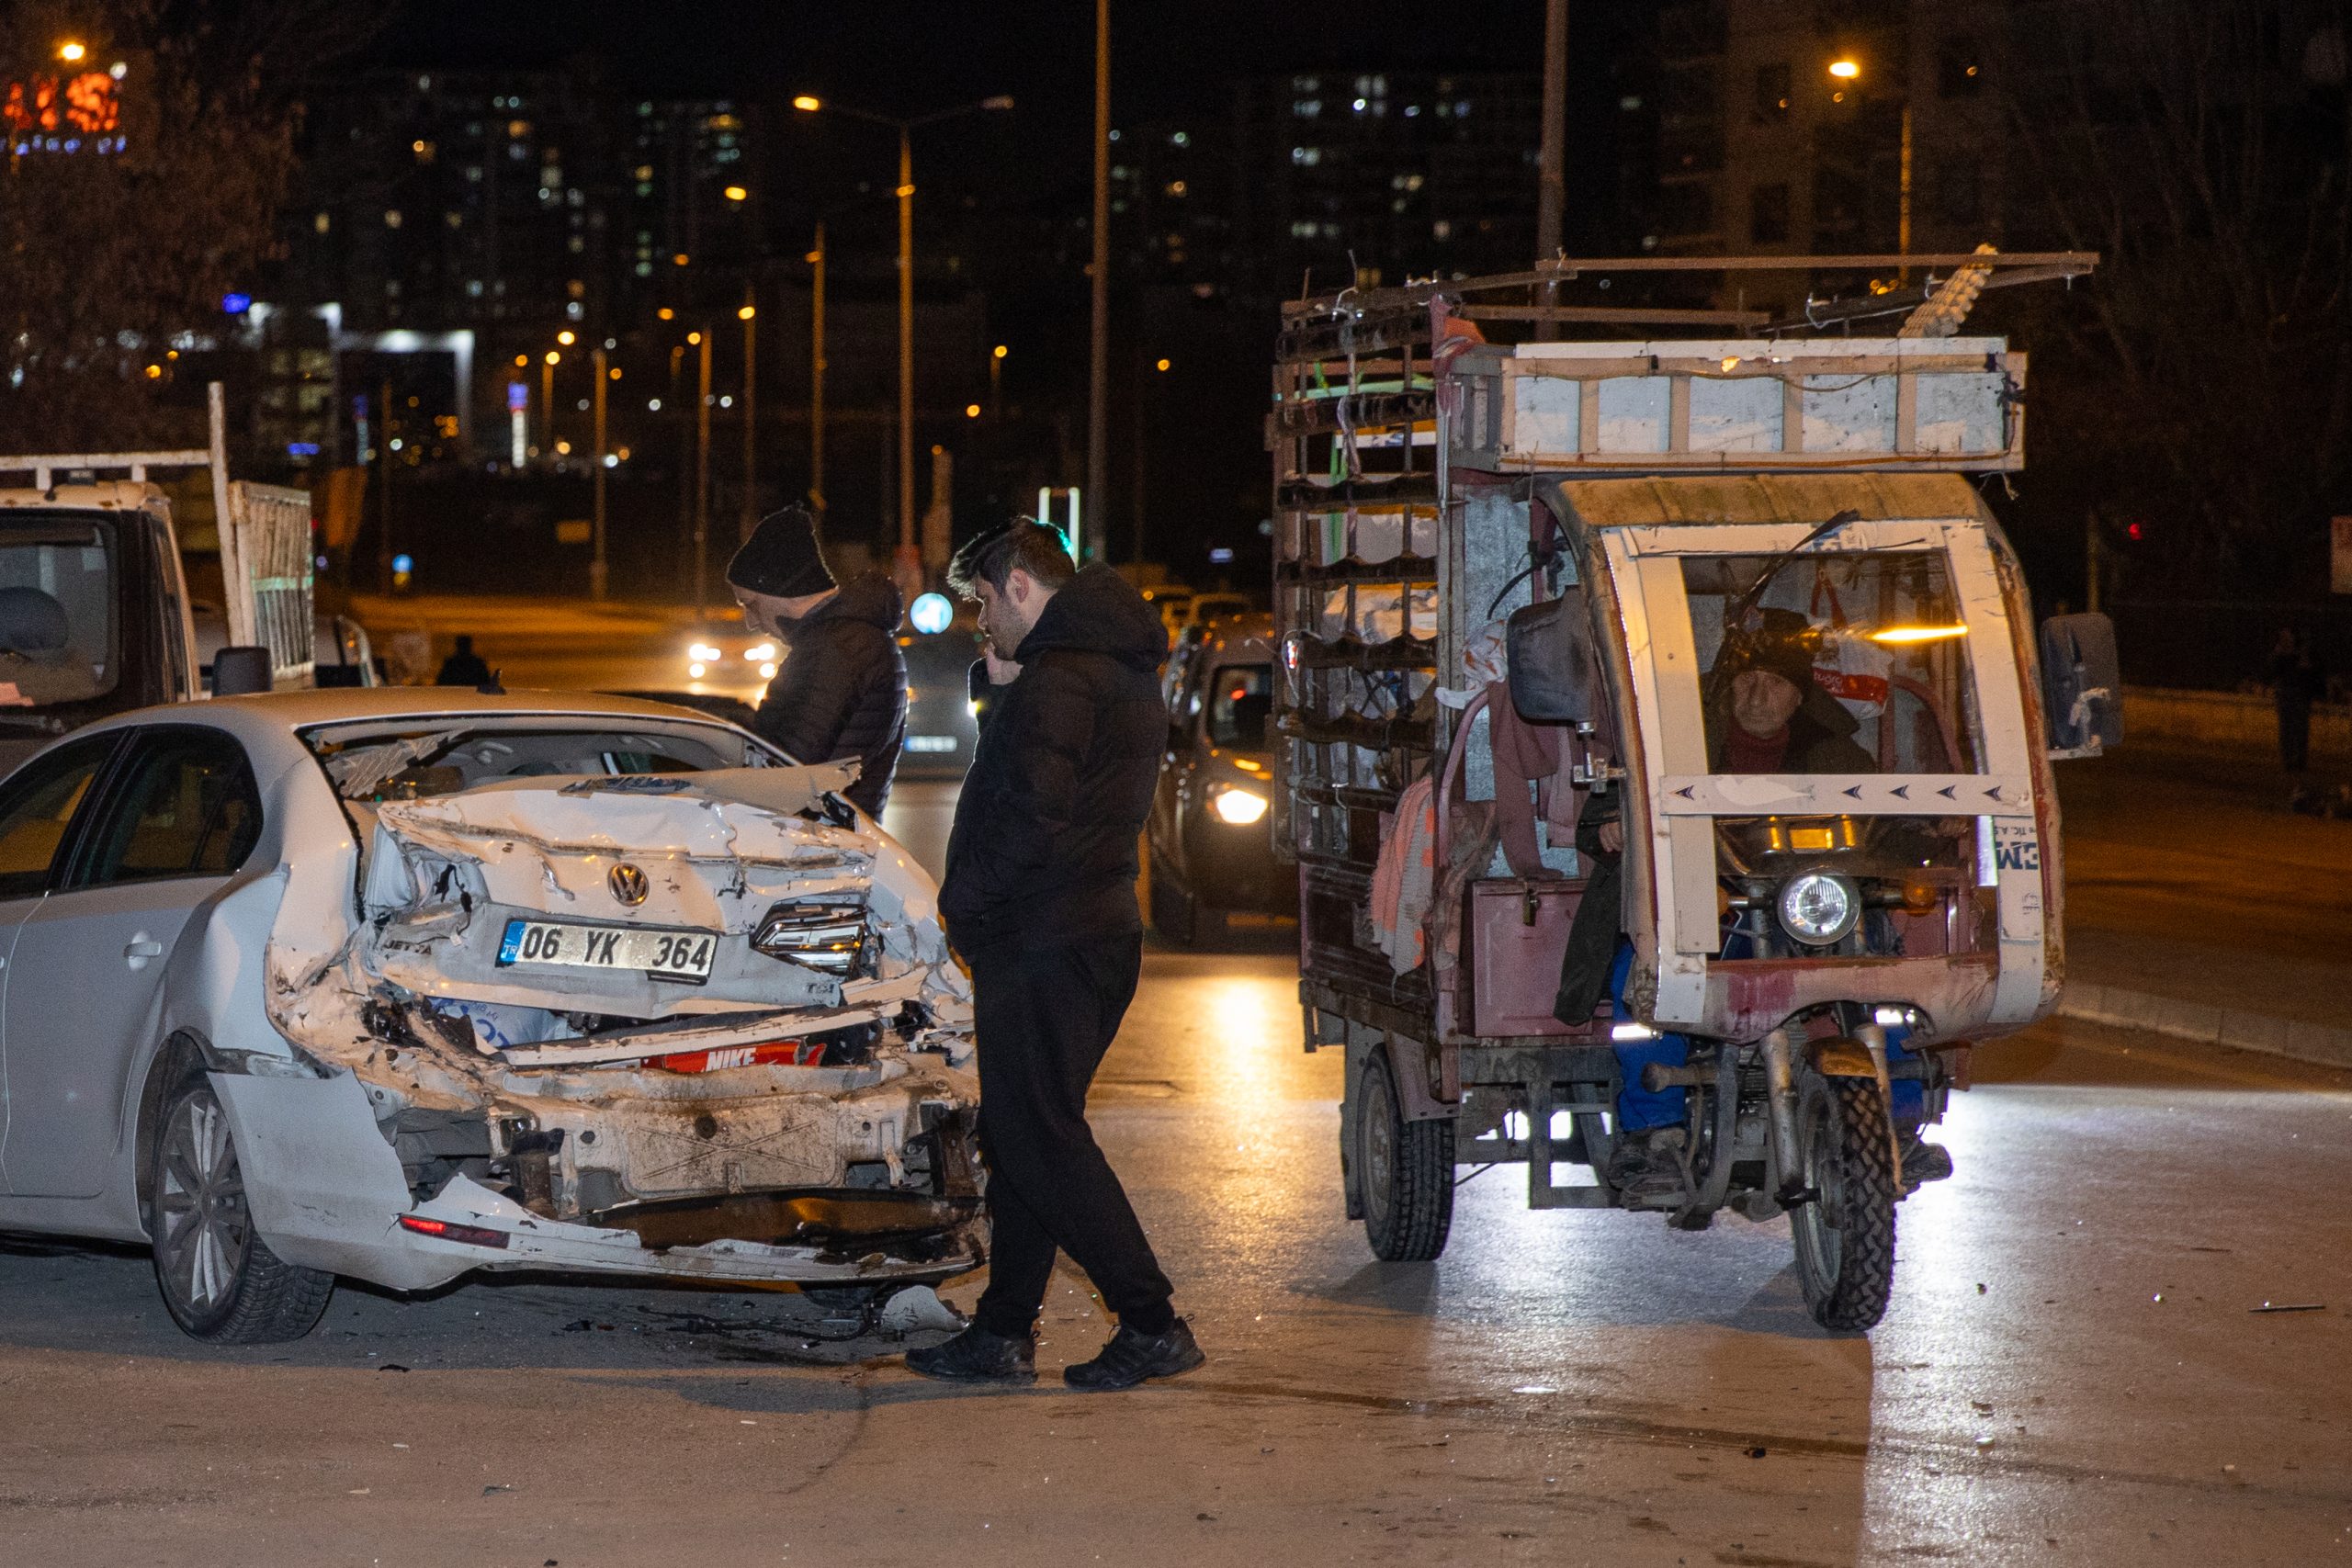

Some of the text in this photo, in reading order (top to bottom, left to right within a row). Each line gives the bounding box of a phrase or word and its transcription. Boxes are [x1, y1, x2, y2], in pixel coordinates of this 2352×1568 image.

[504, 944, 518, 954] TR
[522, 926, 710, 972] 06 YK 364
[706, 1046, 757, 1072] NIKE
